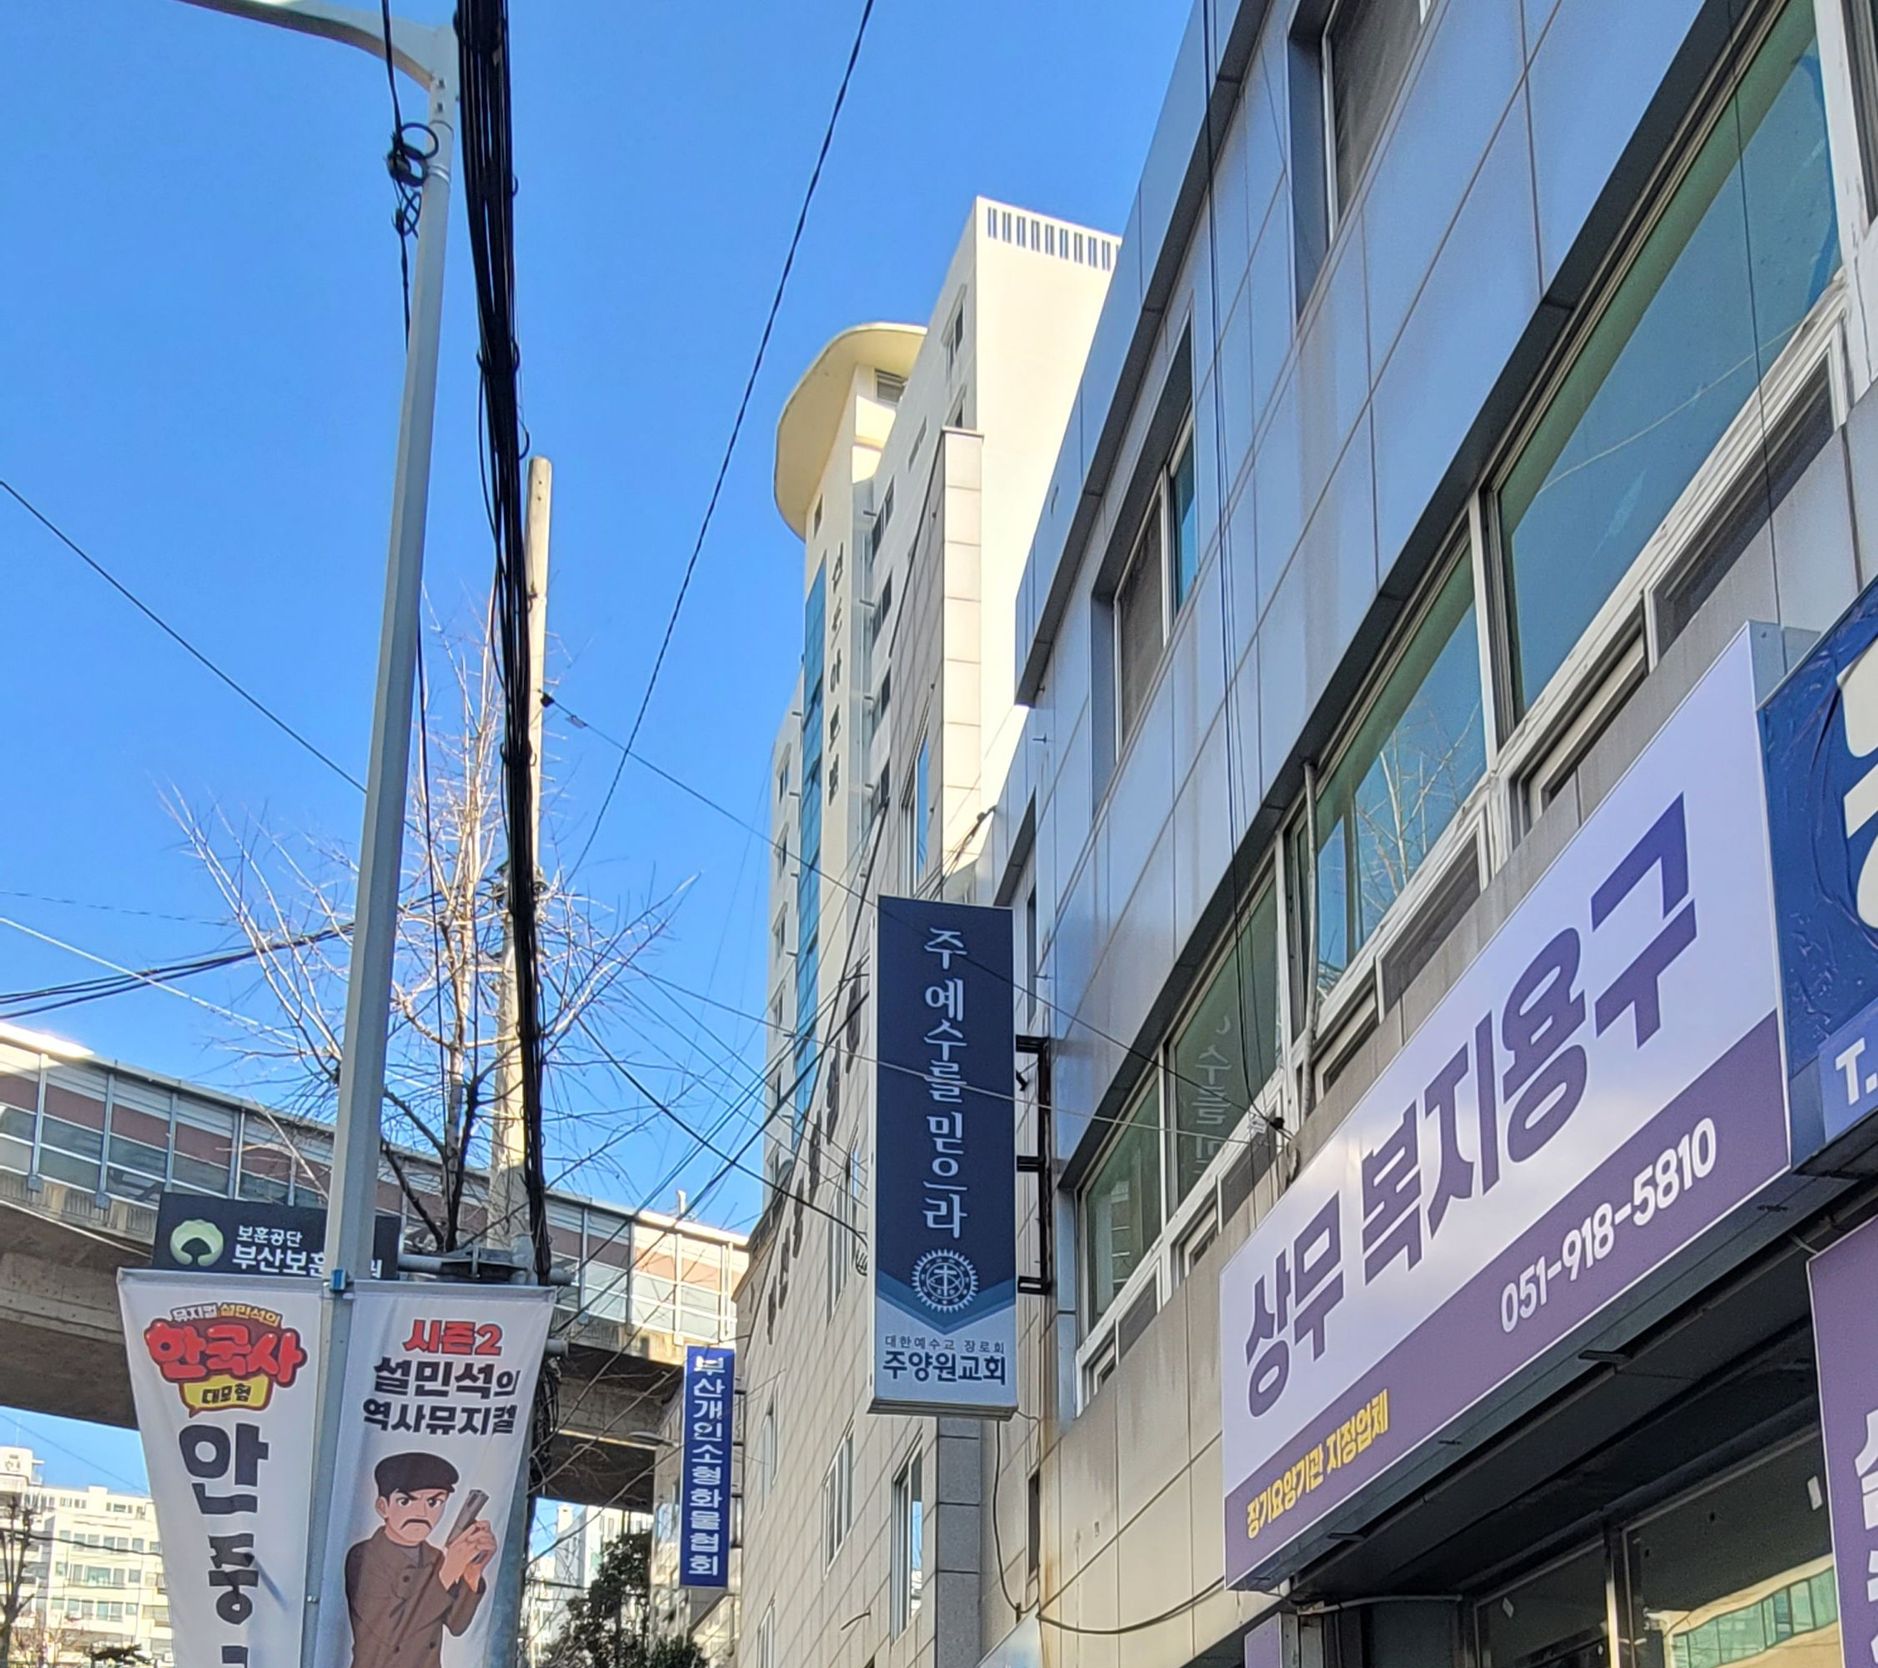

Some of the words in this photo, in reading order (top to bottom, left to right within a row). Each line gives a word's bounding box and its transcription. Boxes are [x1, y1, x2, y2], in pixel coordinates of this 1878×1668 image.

[924, 927, 968, 970] 주
[923, 978, 968, 1103] 예수를
[1245, 1190, 1345, 1418] 상무
[1362, 792, 1698, 1286] 복지용구
[922, 1110, 968, 1239] 믿으라
[237, 1225, 303, 1248] 보훈공단
[1500, 1118, 1717, 1335] 051-918-5810
[232, 1244, 384, 1279] 부산보훈
[171, 1302, 218, 1323] 뮤지컬
[219, 1302, 281, 1326] 설민석의
[144, 1321, 307, 1383] 한국사
[402, 1319, 504, 1357] 시즌2
[884, 1335, 956, 1351] 대한예수교
[963, 1339, 1005, 1355] 장로회
[373, 1356, 521, 1400] 설민석의
[882, 1350, 1006, 1386] 주양원교회
[201, 1383, 252, 1405] 대모험
[362, 1398, 518, 1436] 역사뮤지컬
[687, 1355, 726, 1577] 부산개인소형화물협회
[1247, 1442, 1325, 1540] 장기요양기관
[1325, 1388, 1389, 1475] 지정업체
